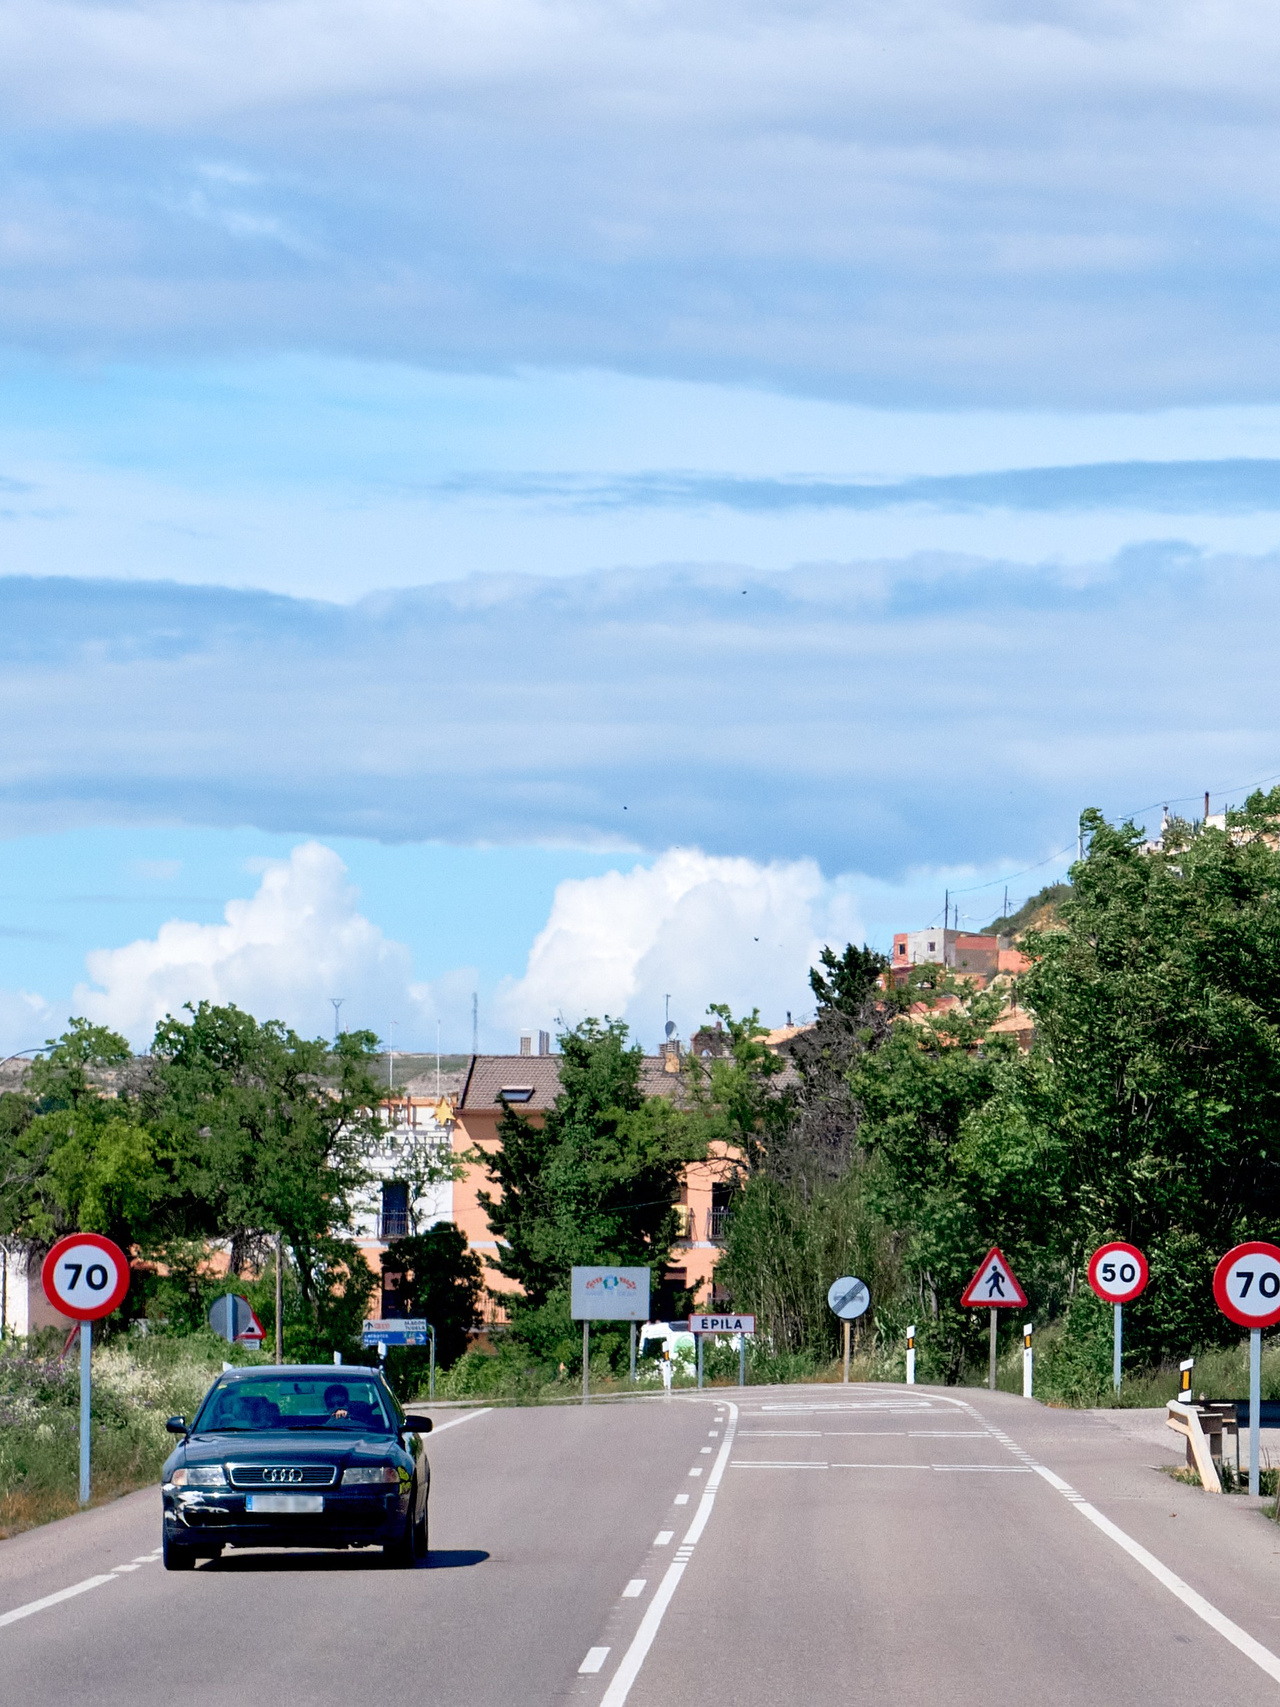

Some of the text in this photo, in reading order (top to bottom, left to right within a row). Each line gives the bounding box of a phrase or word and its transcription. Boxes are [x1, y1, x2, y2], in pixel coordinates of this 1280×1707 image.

[64, 1263, 108, 1291] 70
[1102, 1263, 1136, 1283] 50
[1235, 1271, 1280, 1299] 70
[701, 1316, 743, 1330] ÉPILA
